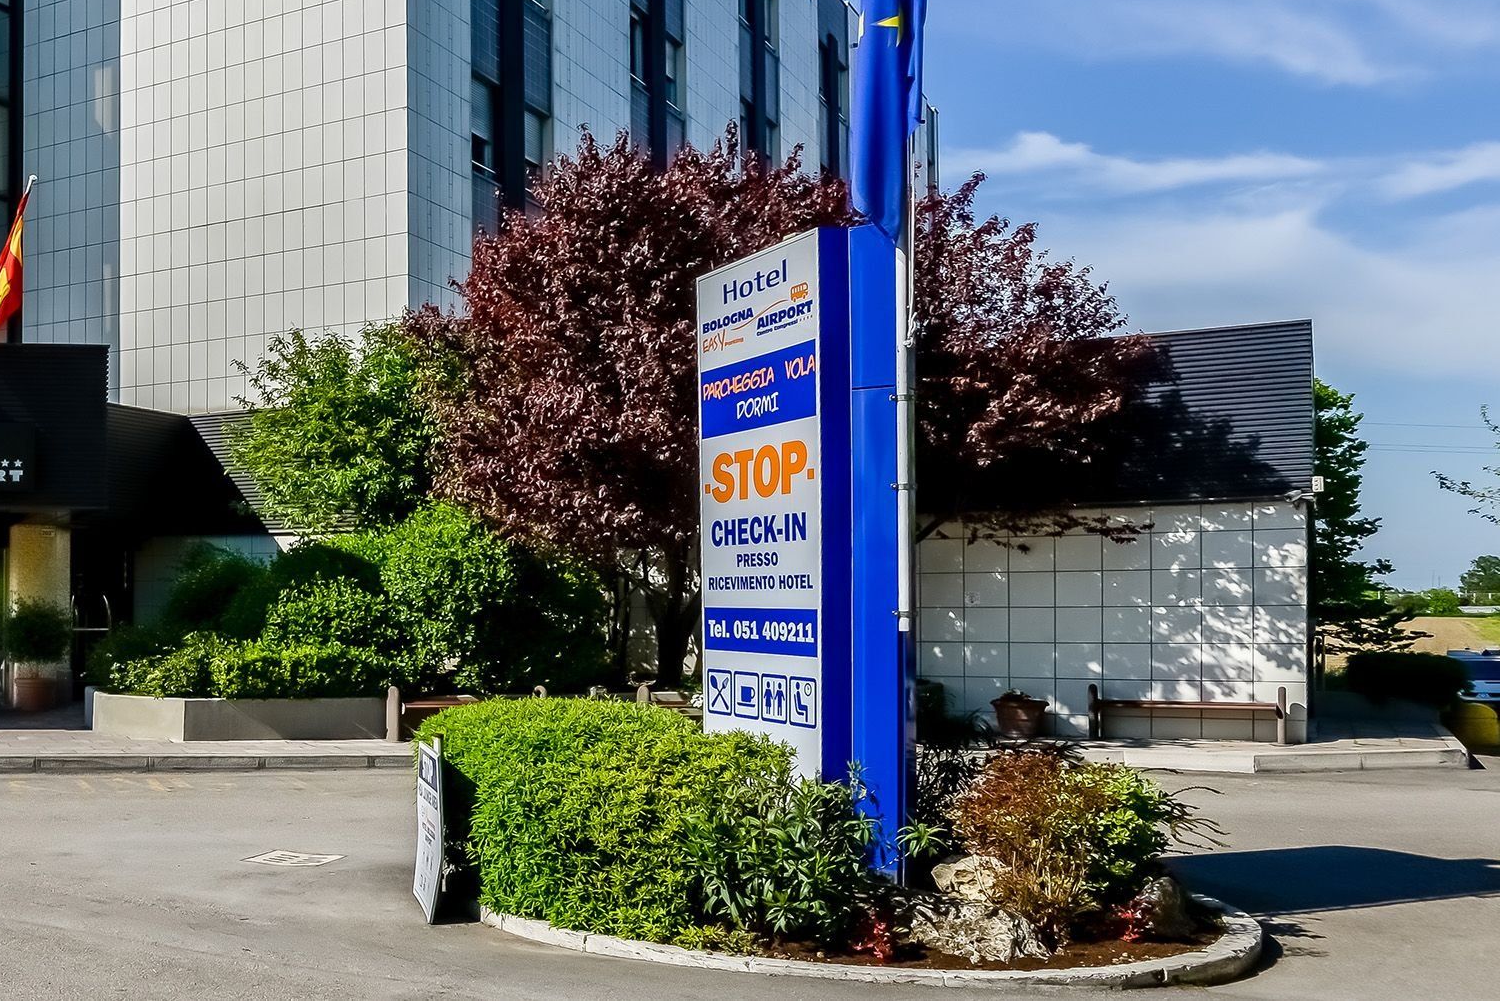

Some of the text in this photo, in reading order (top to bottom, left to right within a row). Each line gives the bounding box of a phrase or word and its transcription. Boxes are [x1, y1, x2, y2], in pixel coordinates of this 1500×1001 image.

[723, 259, 787, 305] Hotel
[703, 300, 813, 334] BOLOGNA AIRPORT
[702, 329, 726, 353] EASY
[702, 354, 816, 401] PARCHEGGIA VOLA
[736, 391, 780, 420] DORMI
[711, 512, 807, 548] CHECK-IN
[736, 552, 779, 567] PRESSO
[708, 574, 814, 591] RICEVIMENTO HOTEL
[708, 619, 815, 643] Tel. 051 409211
